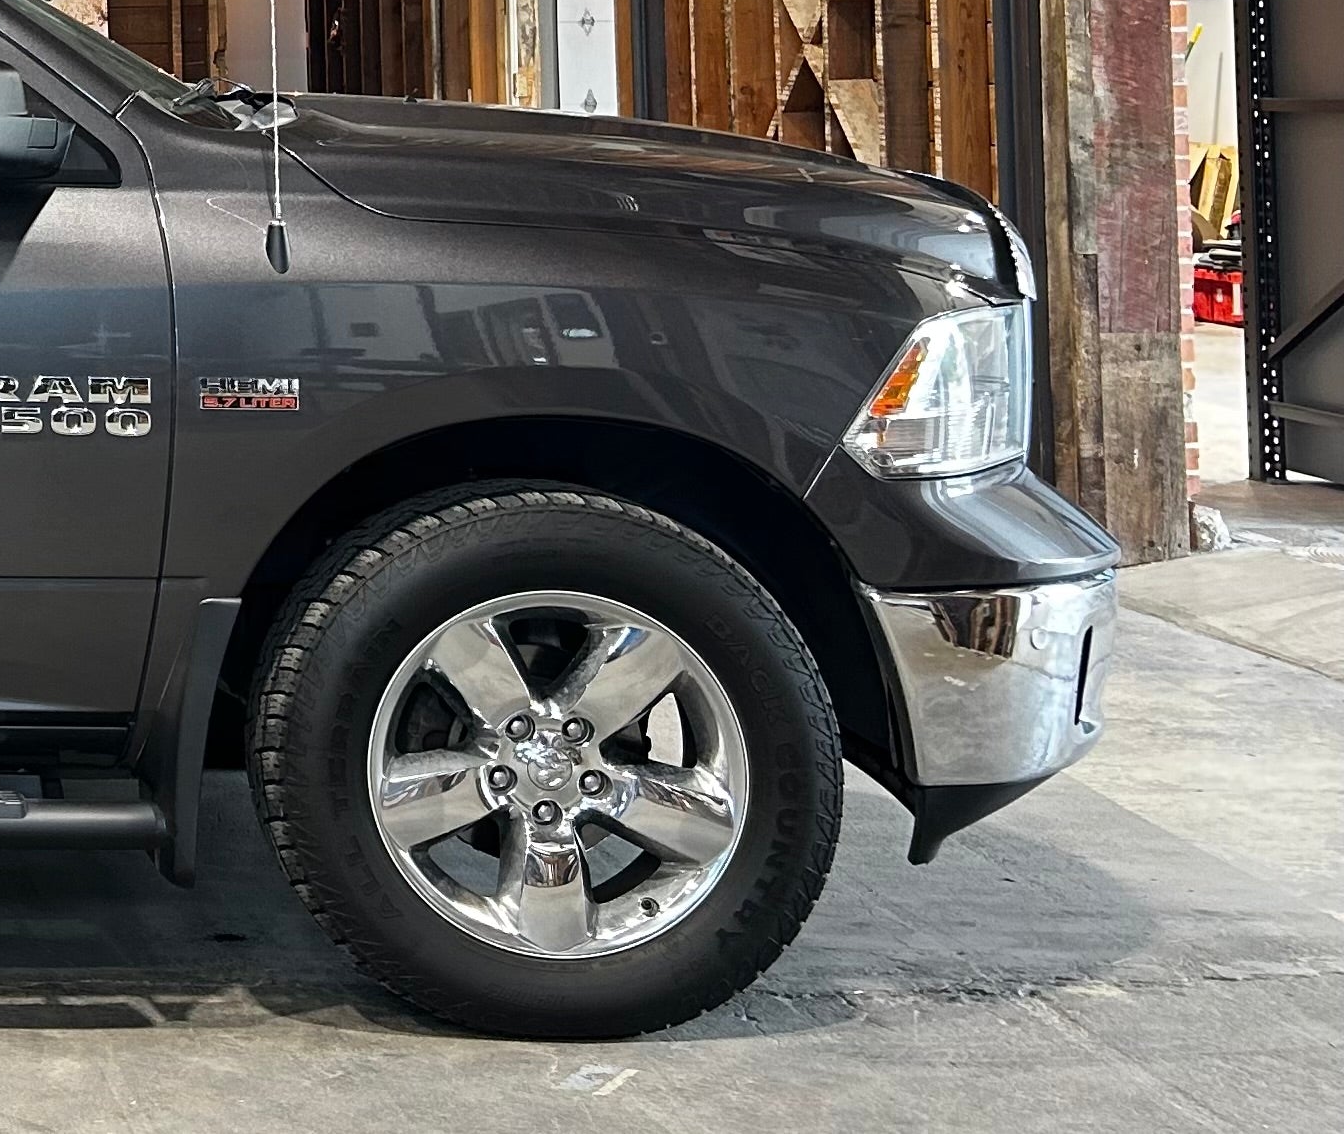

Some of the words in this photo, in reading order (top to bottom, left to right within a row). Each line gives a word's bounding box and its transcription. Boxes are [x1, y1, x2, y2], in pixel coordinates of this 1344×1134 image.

[199, 377, 300, 394] HEMI
[204, 398, 237, 408] 5.7
[239, 398, 295, 408] LITER
